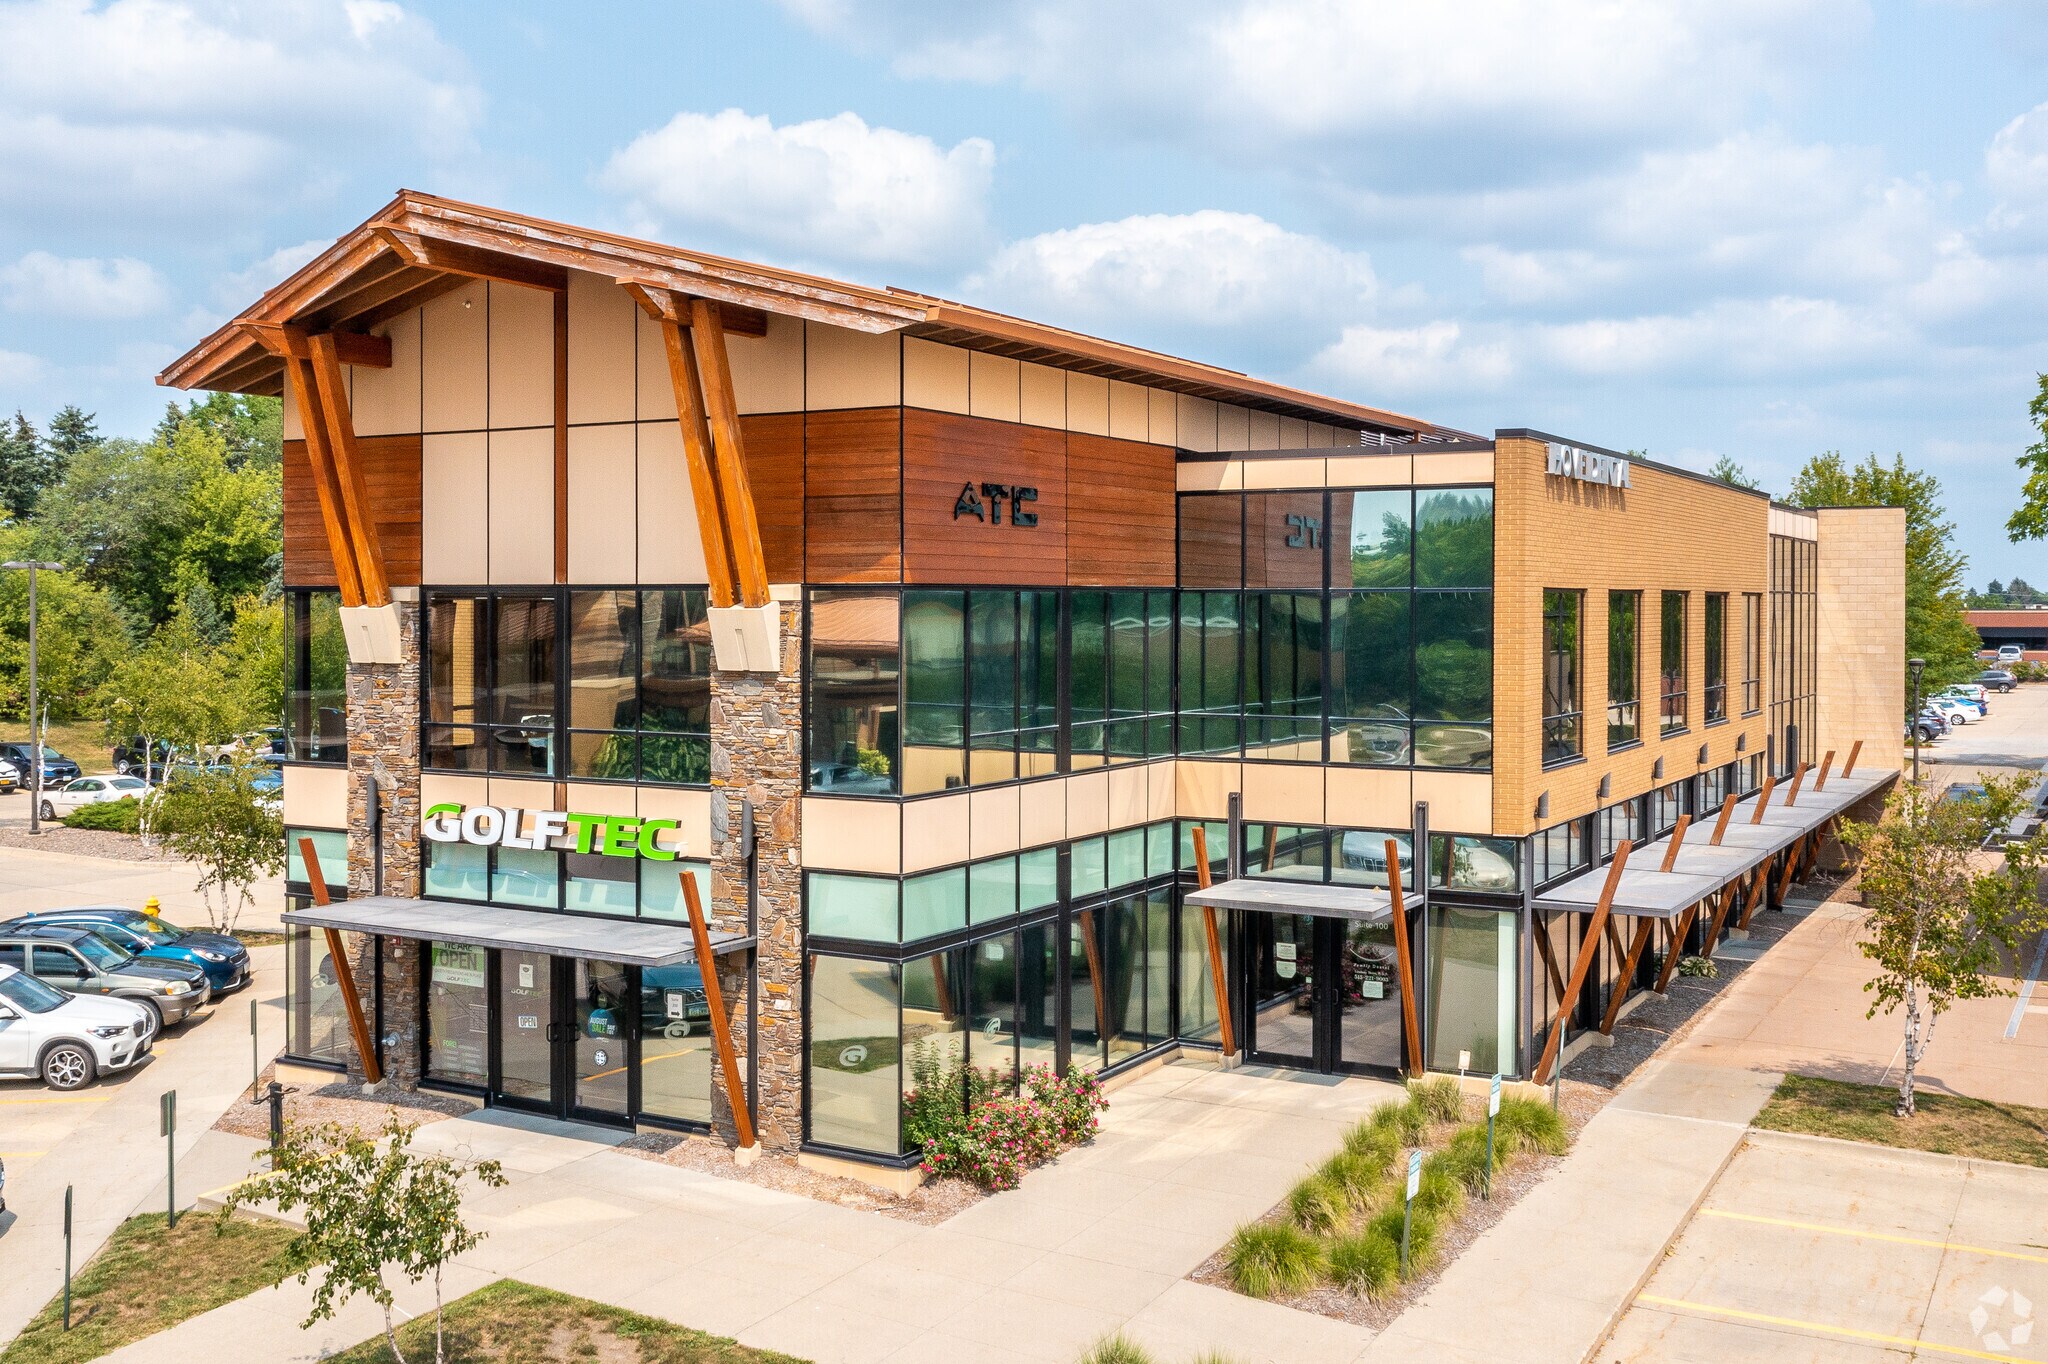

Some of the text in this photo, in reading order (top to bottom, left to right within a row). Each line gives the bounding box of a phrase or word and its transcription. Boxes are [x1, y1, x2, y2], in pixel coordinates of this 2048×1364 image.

[954, 481, 1039, 527] ATC
[424, 802, 682, 861] GOLFTEC
[1375, 922, 1389, 930] 100
[440, 949, 478, 971] OPEN
[519, 1016, 537, 1027] OPEN
[589, 1017, 608, 1026] AUGUST
